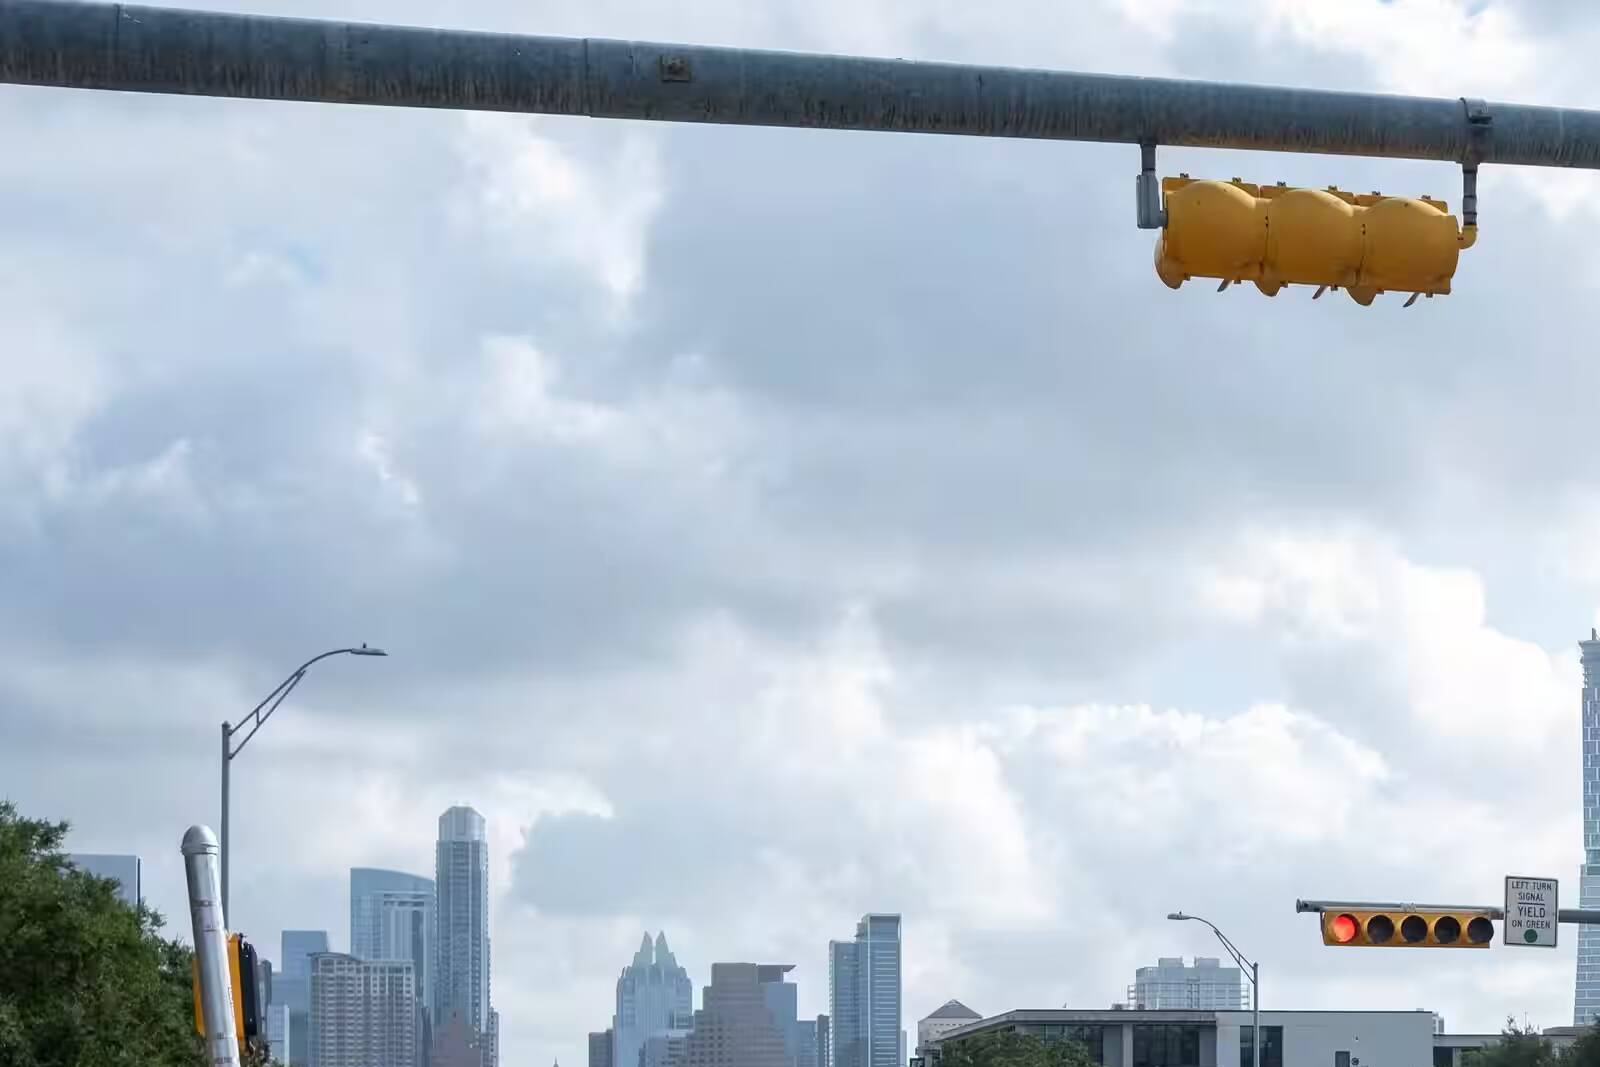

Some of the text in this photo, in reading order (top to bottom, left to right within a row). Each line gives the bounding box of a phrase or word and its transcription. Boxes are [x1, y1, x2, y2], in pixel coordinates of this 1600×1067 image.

[1511, 881, 1552, 890] LEFT TURN
[1518, 892, 1545, 901] SIGNAL
[1518, 906, 1546, 918] YIELD
[1511, 920, 1552, 929] ON GREEN
